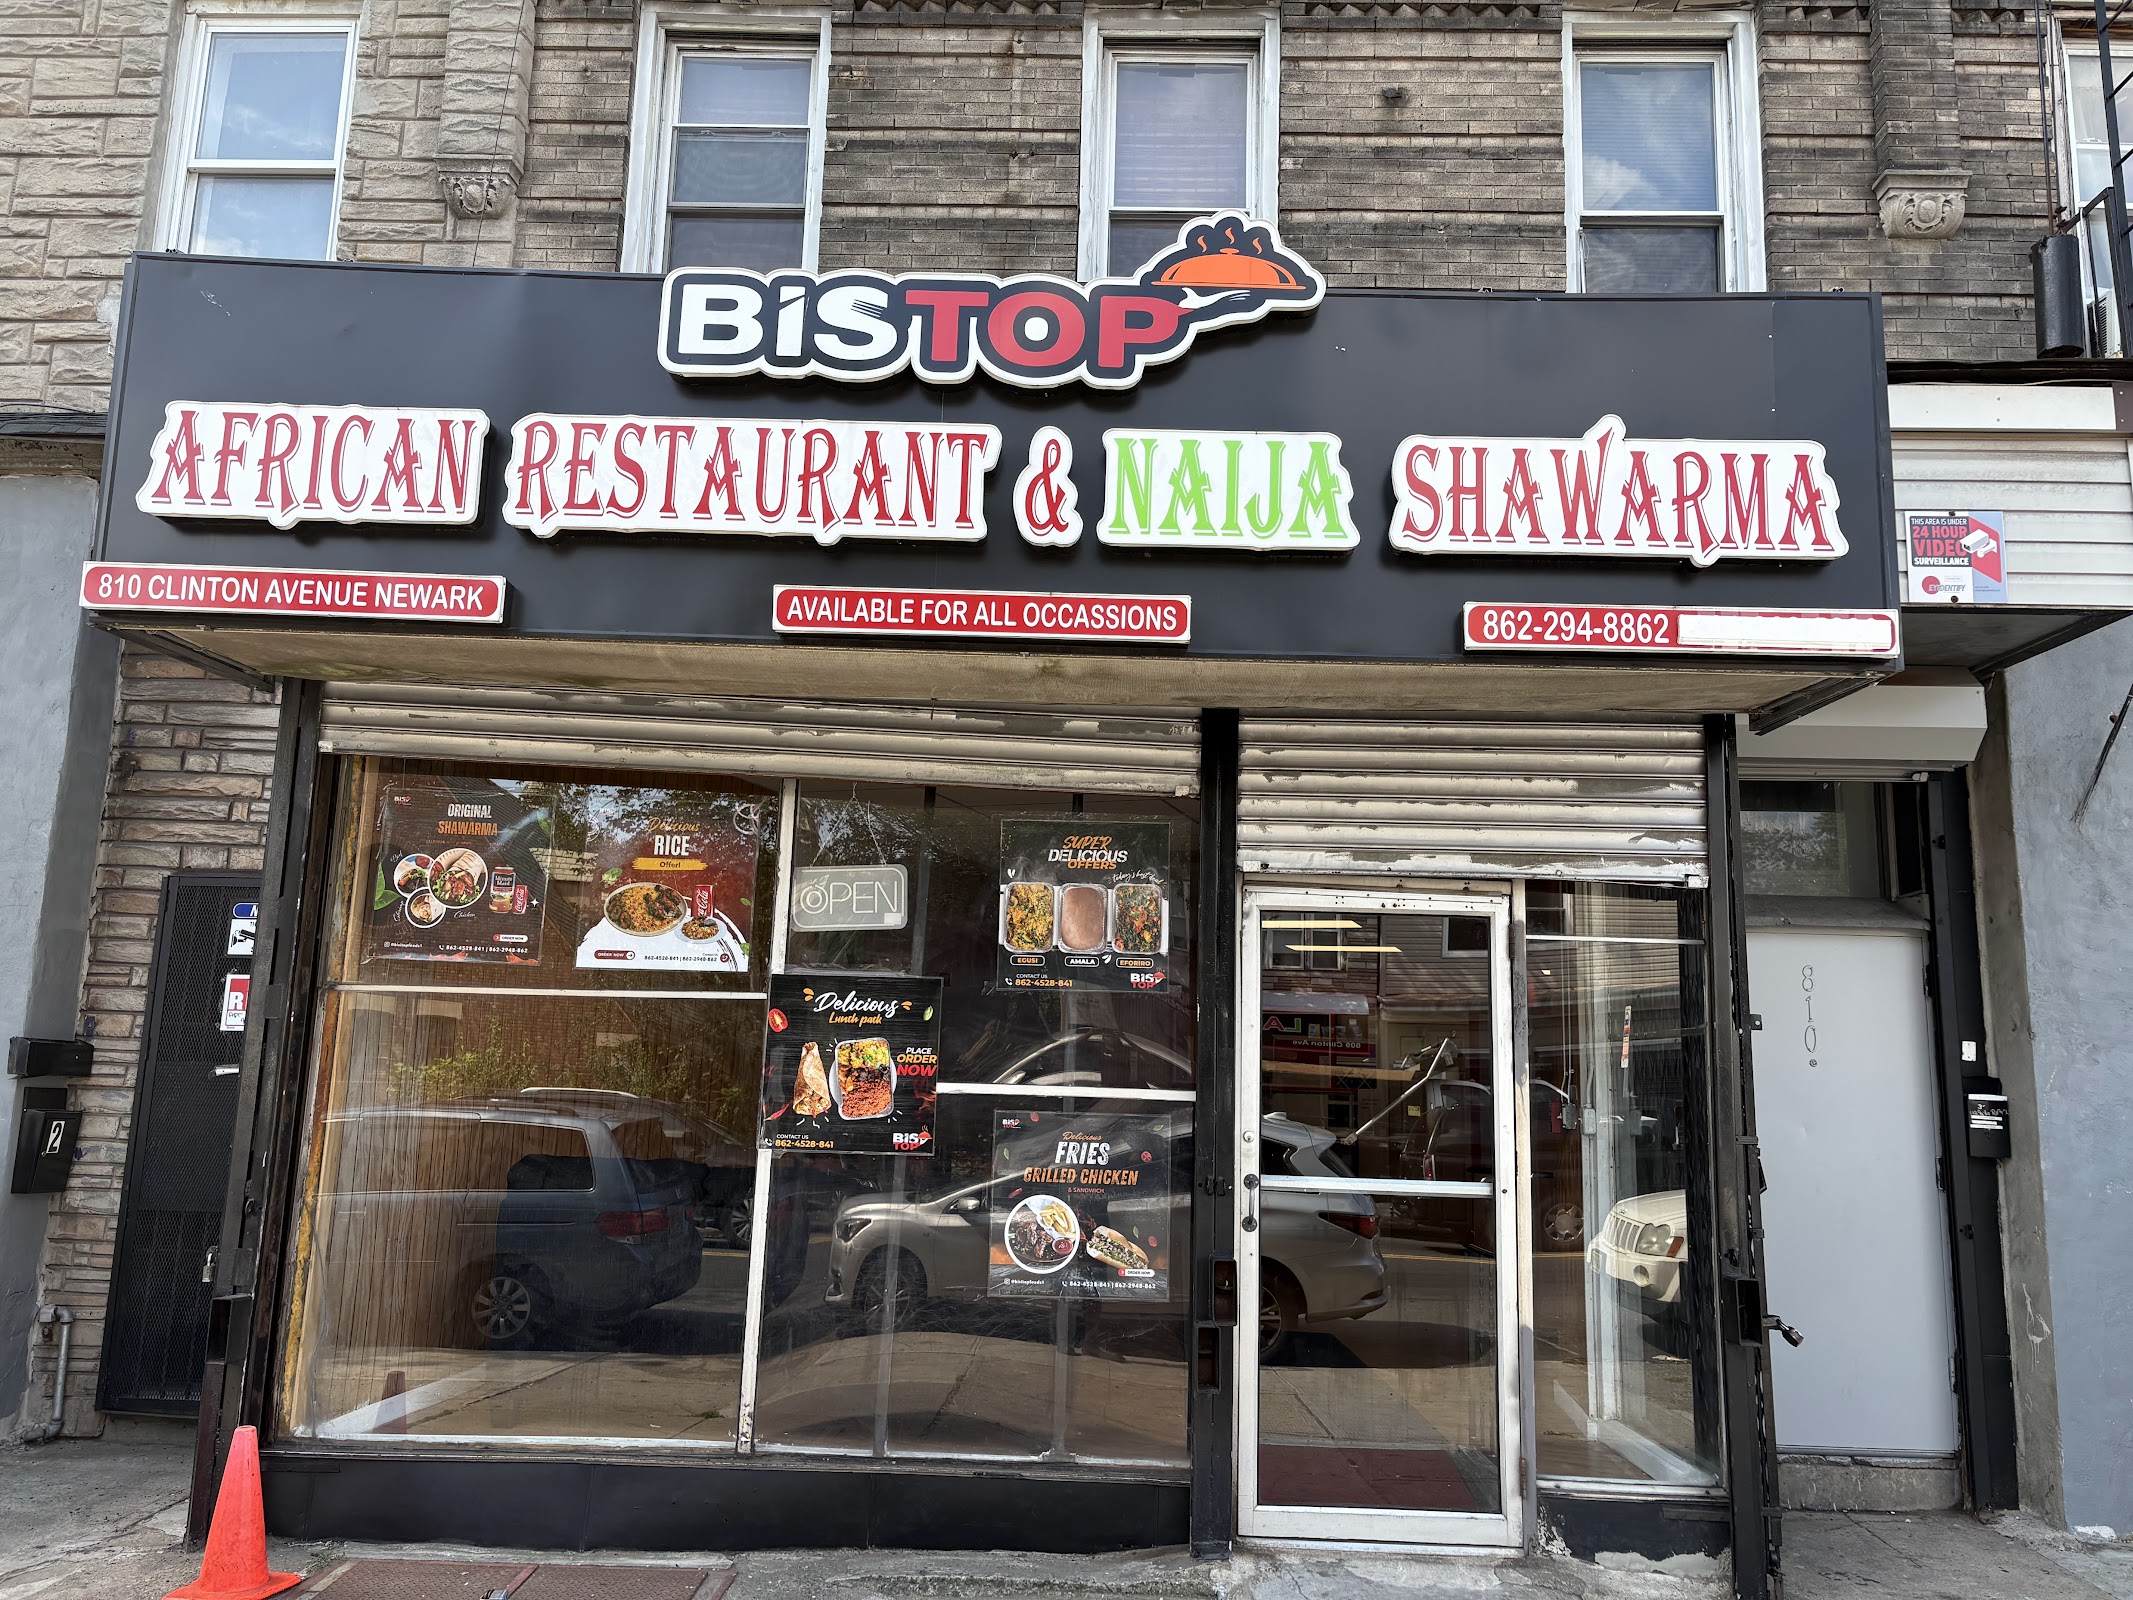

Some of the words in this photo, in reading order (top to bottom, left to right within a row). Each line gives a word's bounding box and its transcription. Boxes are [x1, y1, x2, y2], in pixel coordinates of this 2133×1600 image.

[151, 409, 477, 518] AFRICAN
[514, 419, 988, 527] RESTAURANT
[1023, 438, 1070, 535] &
[1106, 438, 1346, 538] NAIJA
[1400, 426, 1837, 557] SHAWARMA
[1948, 518, 1968, 526] UNDER
[1912, 525, 1930, 539] 24
[1931, 525, 1968, 539] HOUR
[1914, 557, 1970, 566] SURVEILLANCE
[98, 572, 141, 599] 810
[147, 574, 262, 604] CLINTON
[264, 578, 368, 607] AVENUE
[374, 583, 484, 611] NEWARK
[786, 596, 915, 625] AVAILABLE
[920, 599, 967, 626] FOR
[973, 600, 1017, 627] ALL
[1022, 601, 1178, 631] OCCASSIONS
[1482, 609, 1670, 644] 862-294-8862
[447, 803, 492, 819] ORIGINAL
[437, 820, 499, 837] SHAWARMA
[648, 817, 701, 833] Delicious
[653, 834, 691, 856] RICE
[1062, 835, 1113, 850] SUPER
[1047, 849, 1129, 863] DELICIOUS
[659, 860, 681, 869] Offer!
[1067, 860, 1118, 870] OFFERS
[800, 880, 898, 915] OPEN
[1069, 958, 1096, 966] AMALA
[1119, 959, 1151, 967] EFORIRO
[1015, 978, 1073, 987] 862-4528-841
[813, 990, 899, 1019] Delicious
[828, 1011, 859, 1024] Lunch
[905, 1047, 933, 1055] PLACE
[896, 1054, 938, 1064] ORDER
[896, 1064, 938, 1077] NOW
[48, 1122, 63, 1153] 2
[1062, 1131, 1104, 1141] Delicious
[775, 1139, 834, 1149] 862-4528-841
[1054, 1141, 1111, 1166] FRIES
[1023, 1166, 1077, 1184] GRILLED
[1080, 1168, 1139, 1186] CHICKEN
